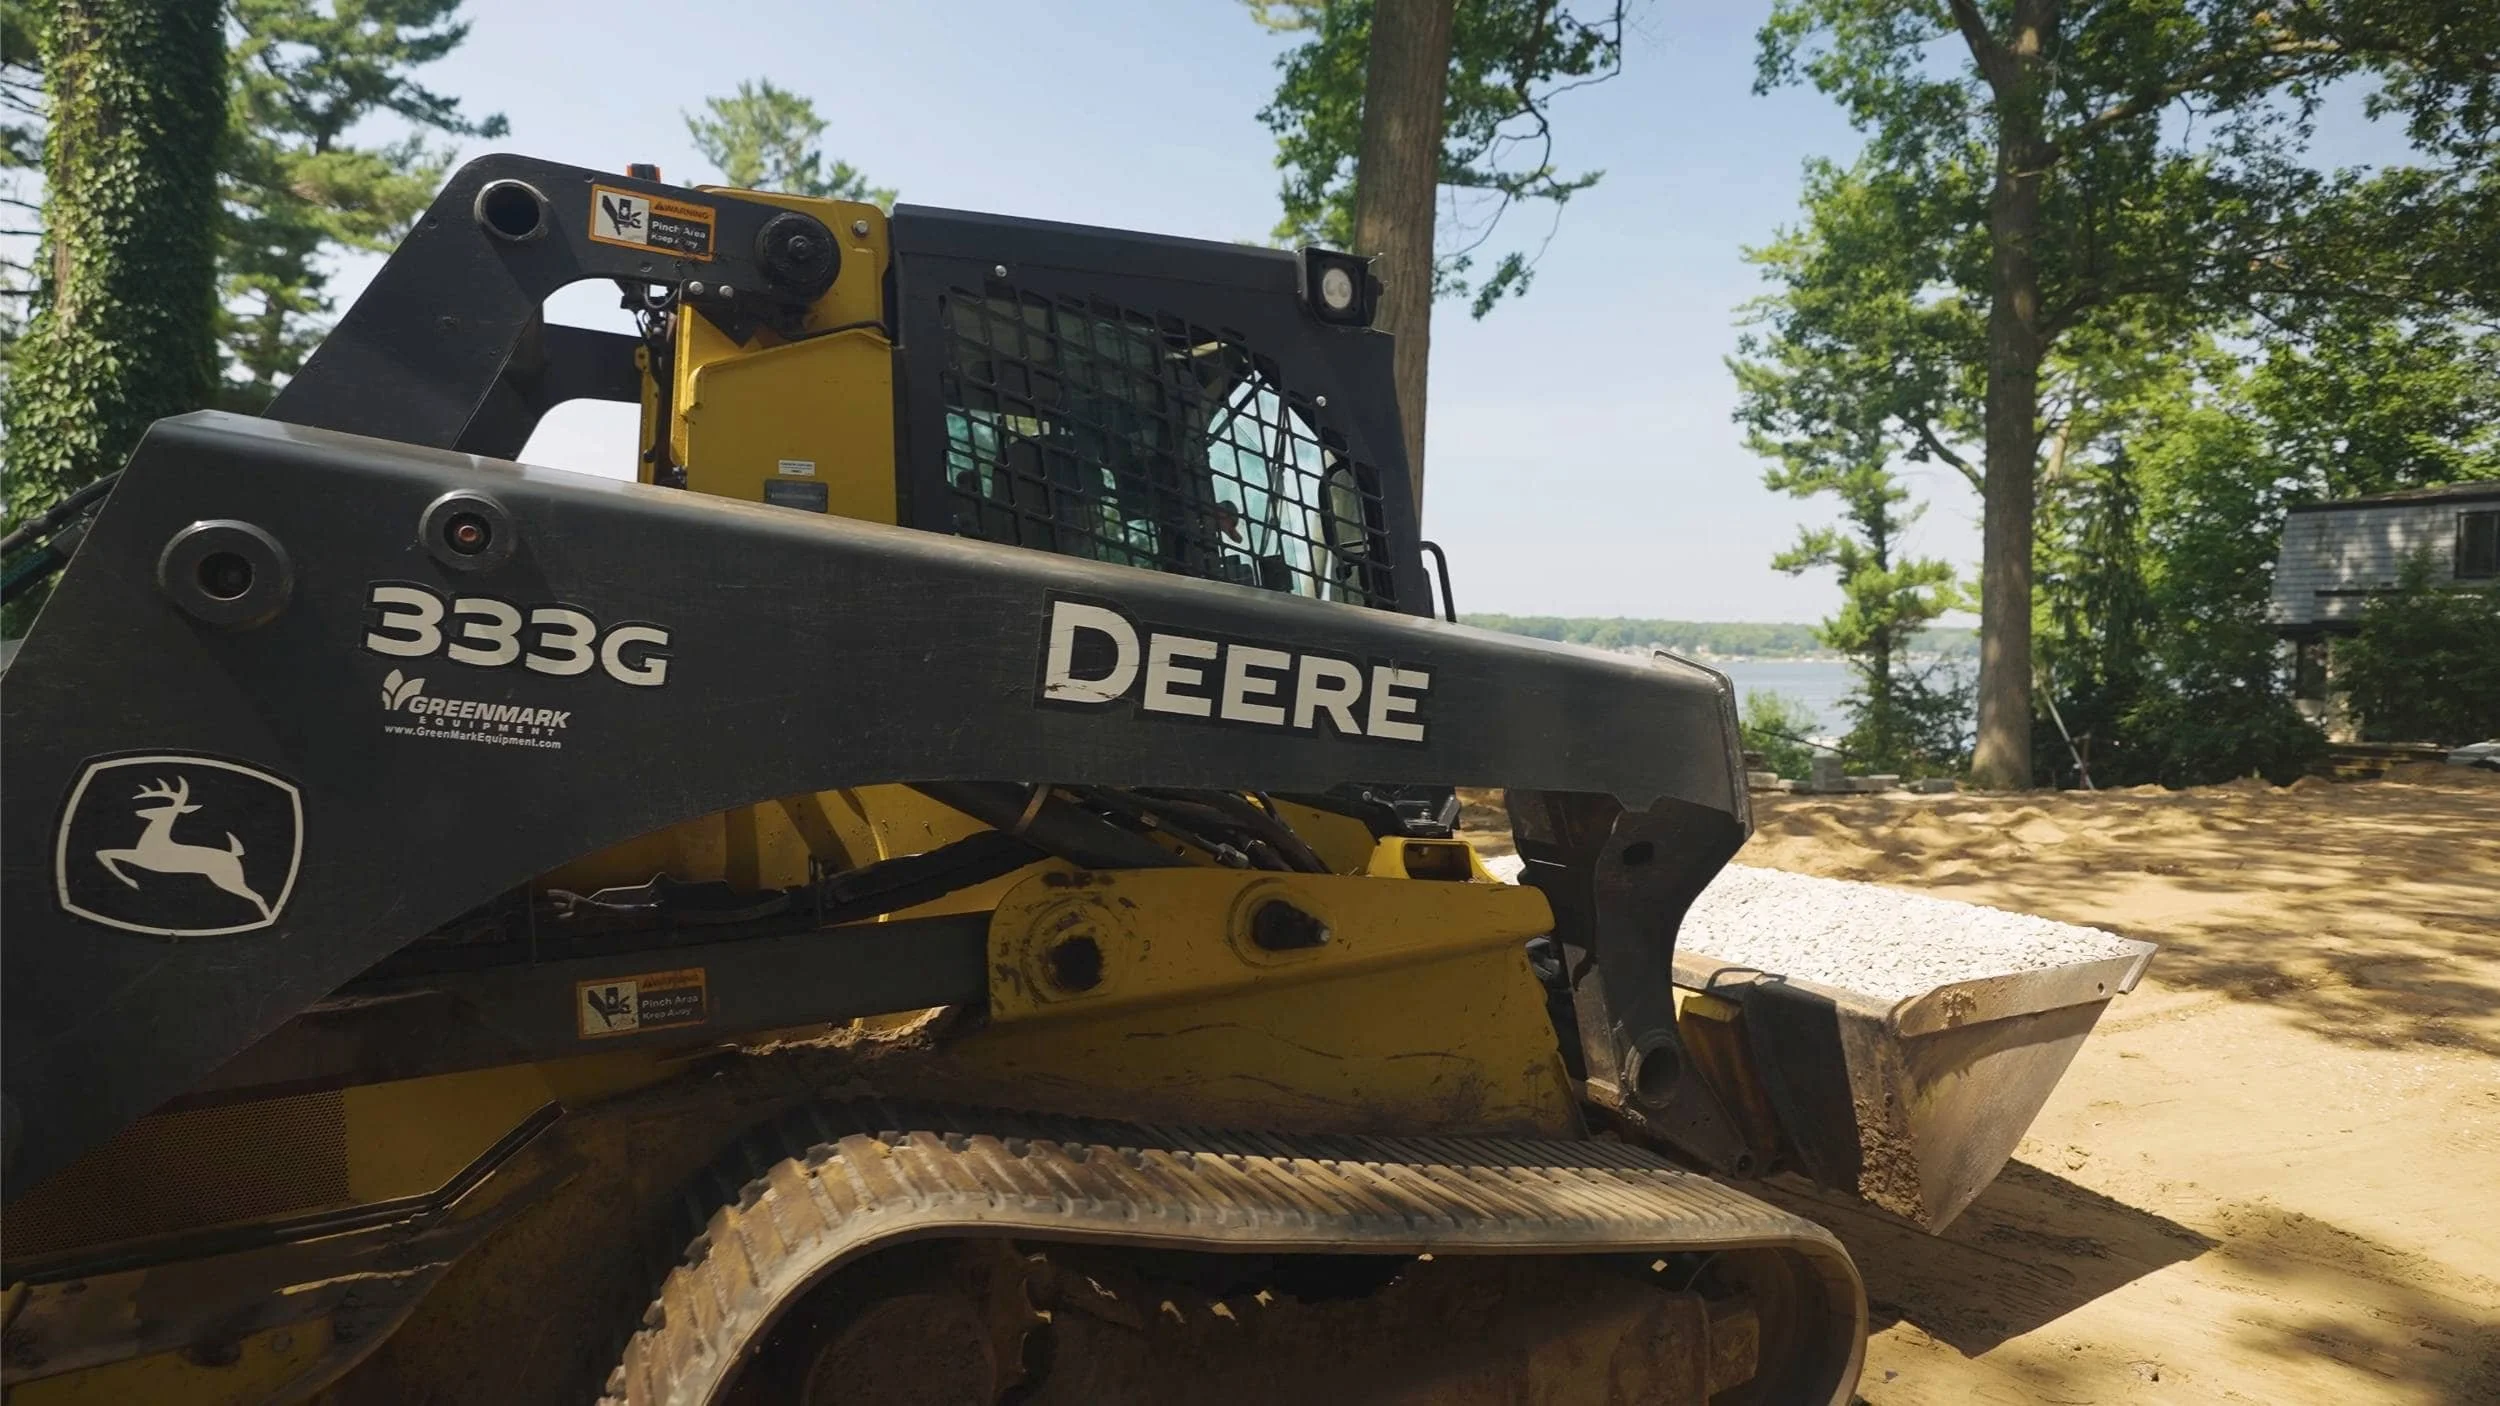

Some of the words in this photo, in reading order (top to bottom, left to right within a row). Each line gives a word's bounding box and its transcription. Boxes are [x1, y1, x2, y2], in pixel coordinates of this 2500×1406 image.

[652, 221, 680, 233] Pinch
[683, 227, 706, 238] Area
[366, 586, 669, 686] 333G
[1044, 600, 1430, 742] DEERE
[408, 696, 571, 729] GREENMARK
[384, 723, 562, 749] www.GreenMarkEquipment.com
[419, 716, 555, 737] EQUIPMENT
[642, 997, 672, 1008] Pinch
[675, 995, 699, 1004] Area
